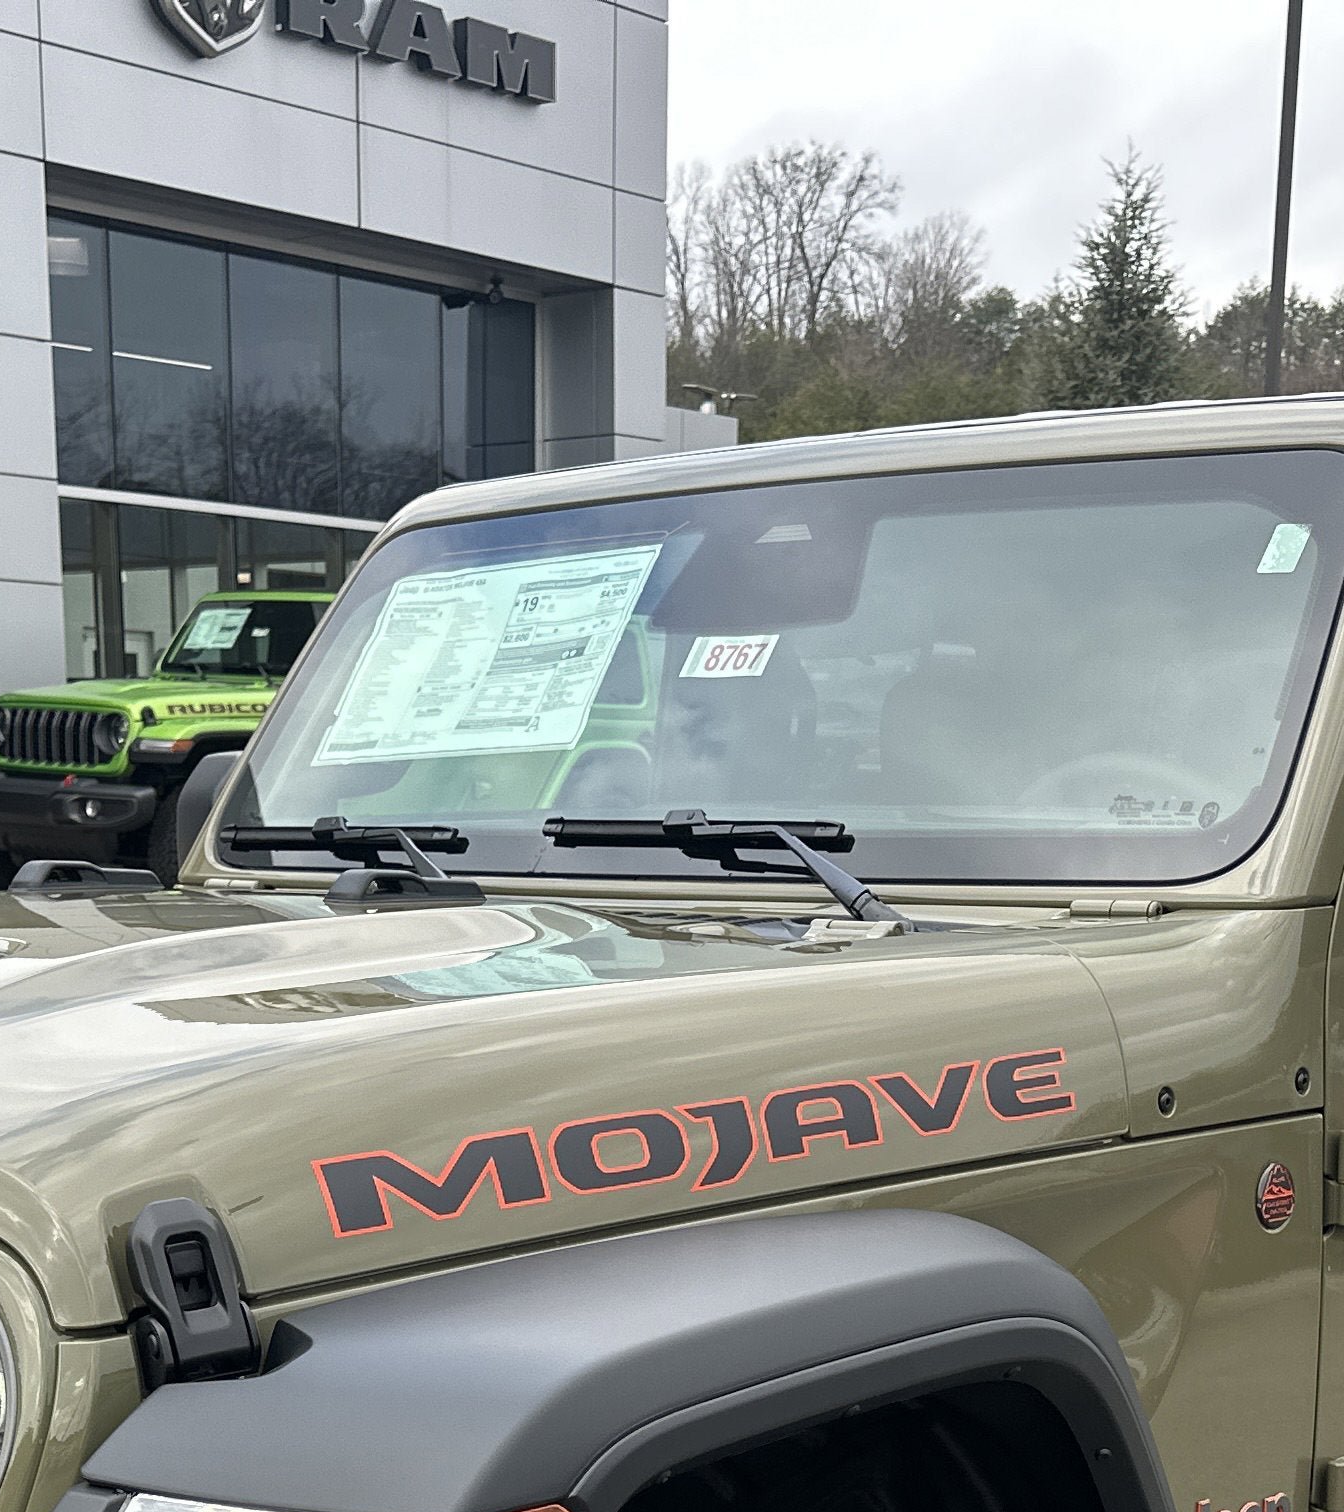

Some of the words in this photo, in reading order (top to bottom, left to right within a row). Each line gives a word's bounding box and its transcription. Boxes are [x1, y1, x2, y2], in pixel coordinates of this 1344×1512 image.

[275, 0, 556, 102] RAM
[522, 596, 540, 613] 19
[703, 642, 768, 672] 8767
[168, 703, 269, 715] RUBICO
[311, 1047, 1077, 1239] MOJAVE
